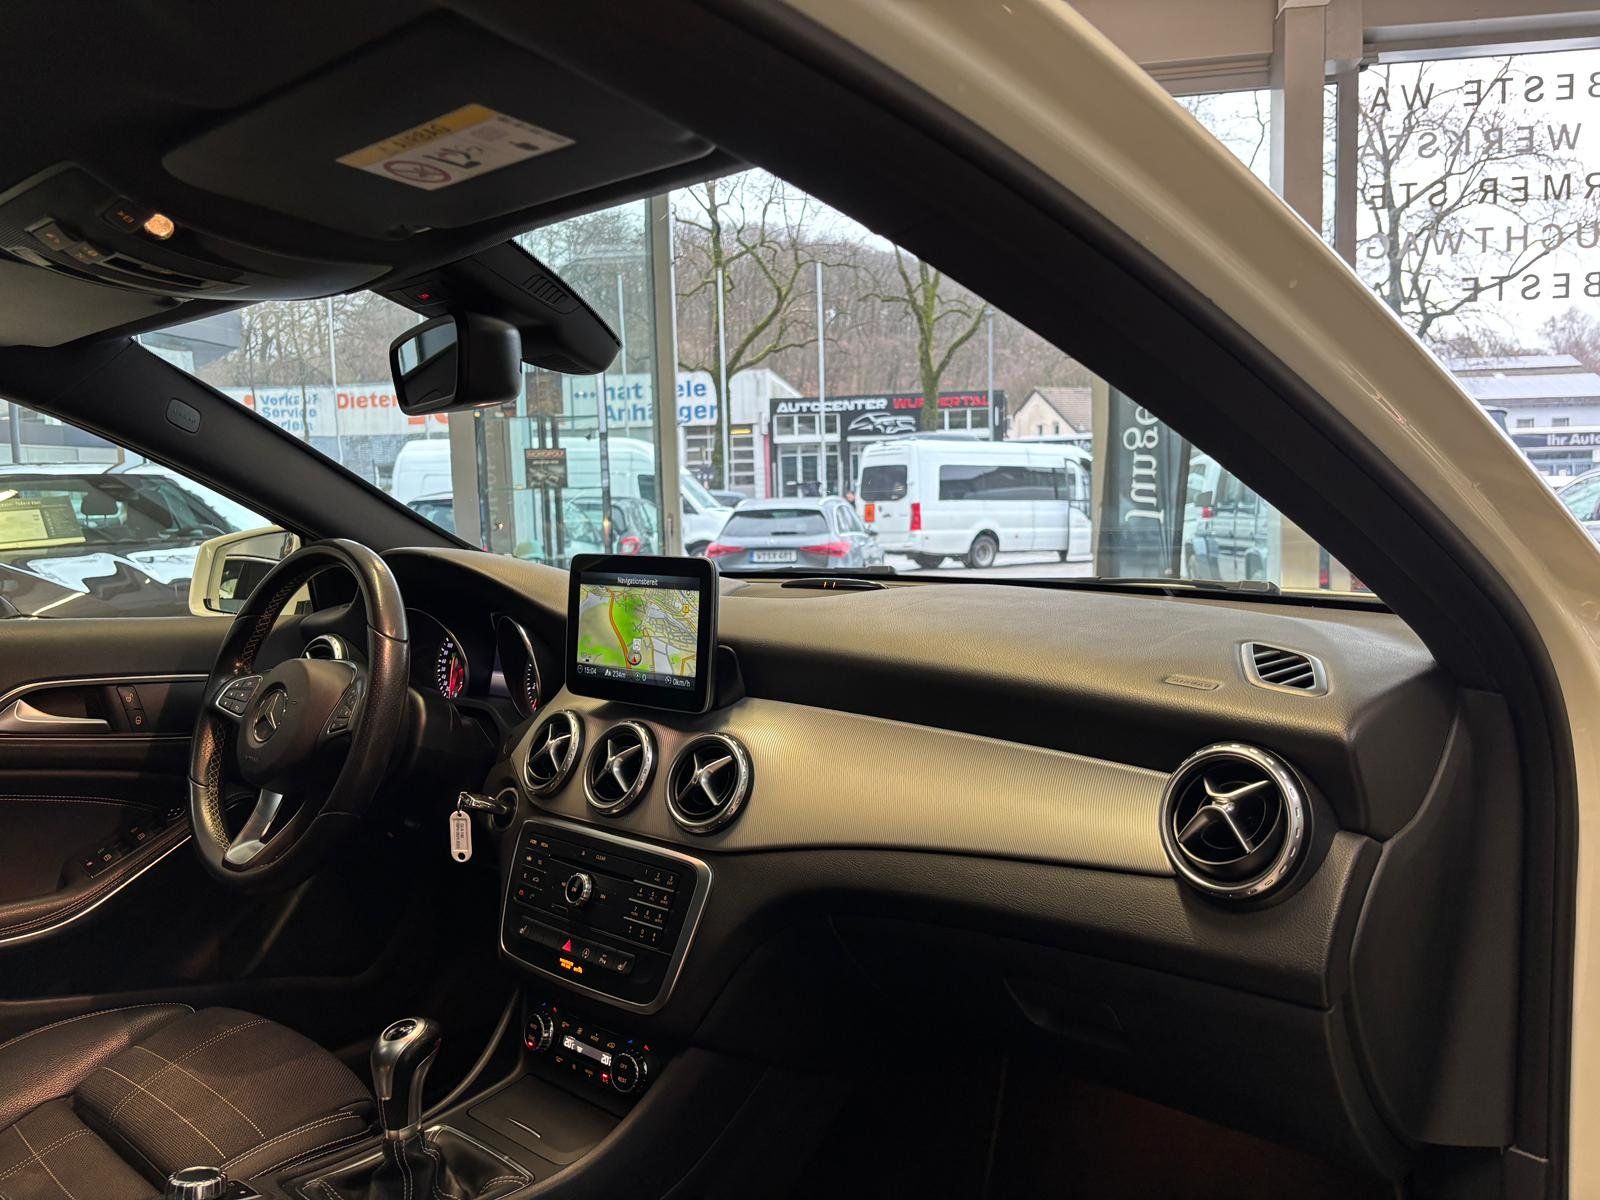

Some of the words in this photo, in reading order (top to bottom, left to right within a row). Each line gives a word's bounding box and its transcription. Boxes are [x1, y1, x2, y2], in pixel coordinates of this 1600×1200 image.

[776, 398, 888, 413] AUTOCENTER
[893, 395, 990, 409] WUPERTAL
[606, 404, 717, 425] Anhäger
[1547, 433, 1567, 446] Ihr
[617, 577, 658, 586] Navigationsbereit
[584, 667, 597, 675] 15:04
